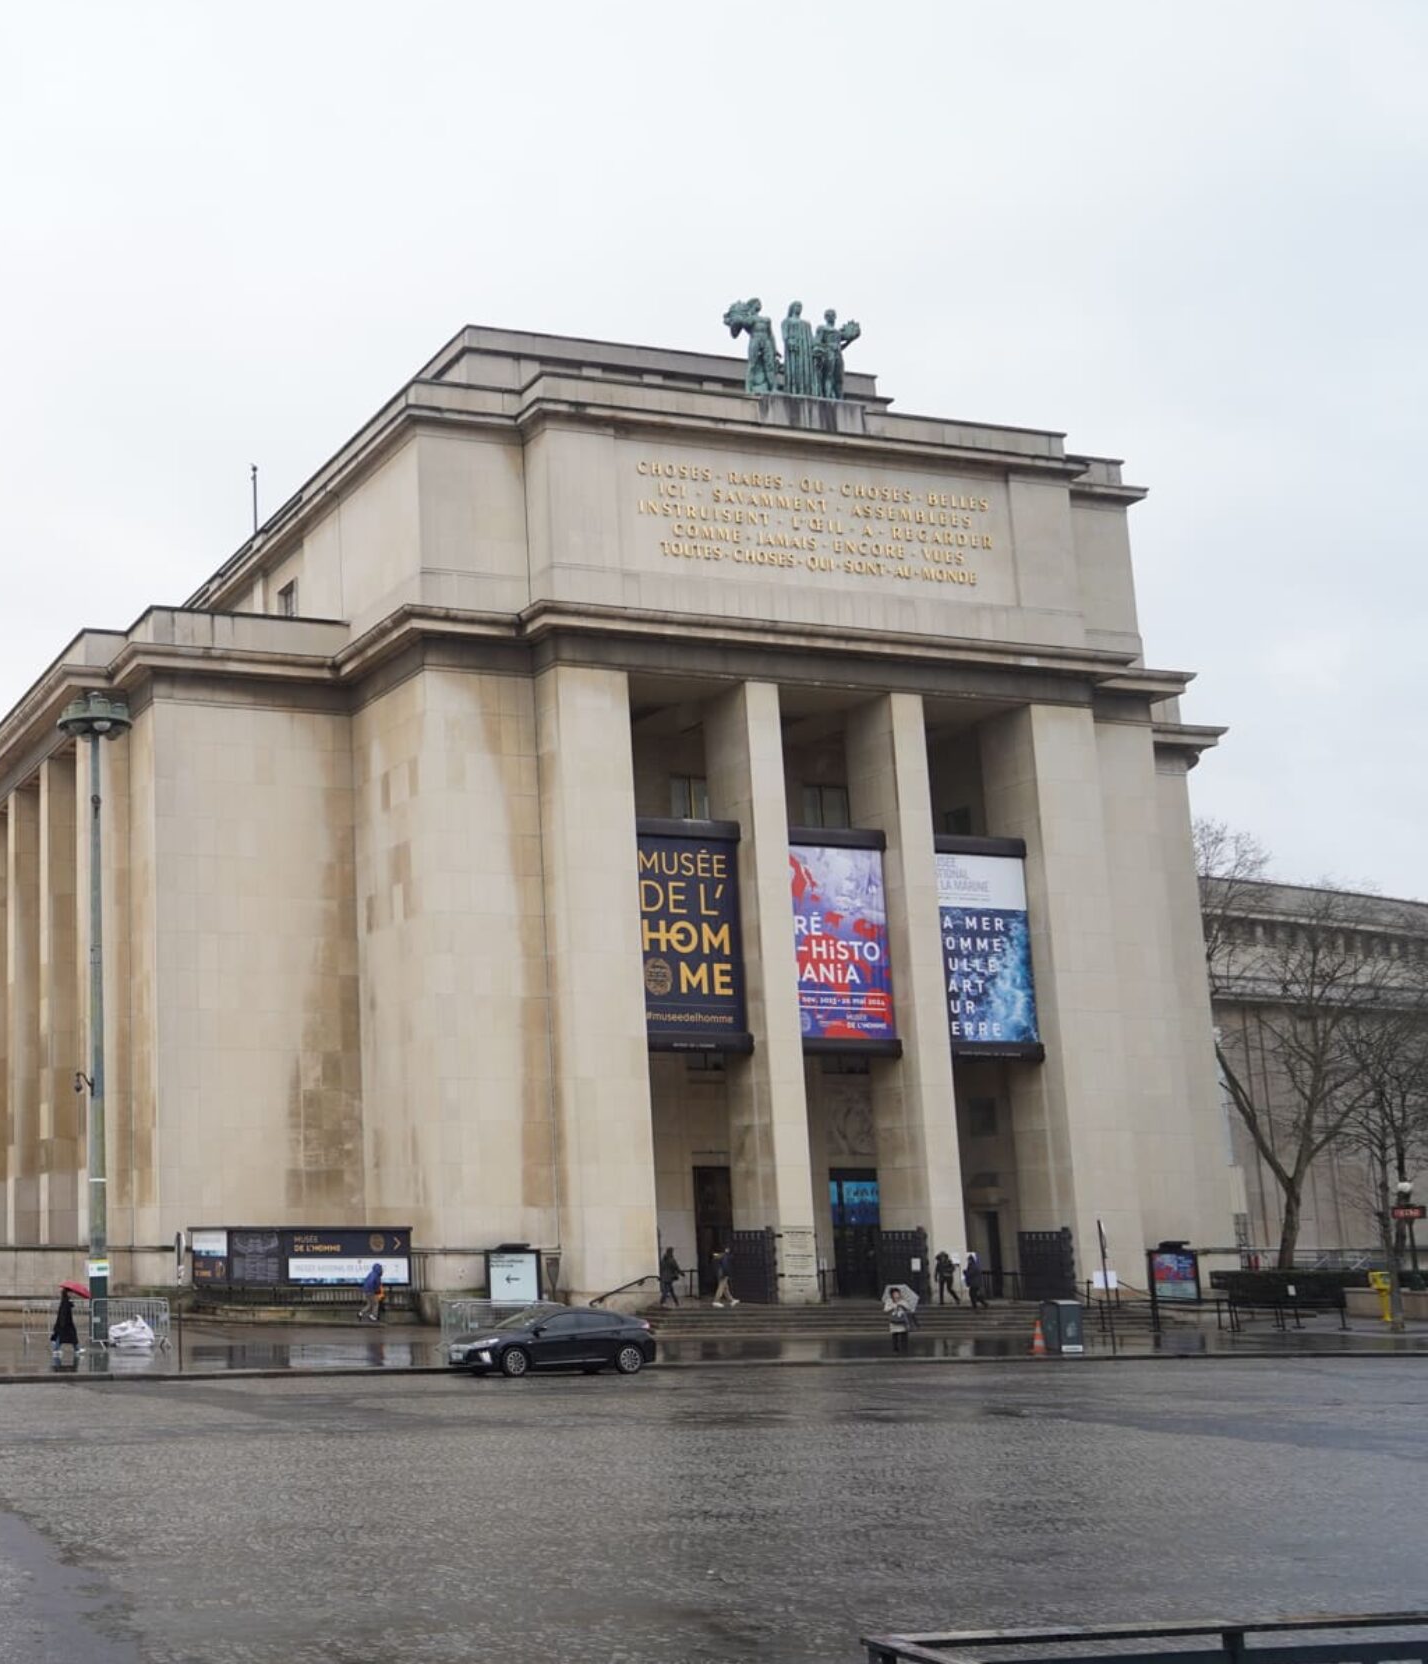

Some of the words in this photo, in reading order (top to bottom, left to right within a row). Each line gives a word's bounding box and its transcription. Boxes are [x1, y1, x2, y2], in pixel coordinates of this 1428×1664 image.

[637, 461, 712, 482] CHOSES
[728, 472, 784, 490] RARES
[800, 478, 824, 495] OU
[840, 483, 912, 503] CHOSES
[927, 493, 989, 512] BELLES
[658, 483, 687, 499] ICI
[712, 489, 827, 514] SAVAMMENT
[638, 500, 770, 527] INSTRUISENT
[862, 525, 873, 537] A
[892, 527, 993, 550] REGARDER
[673, 523, 741, 544] COMME
[756, 531, 818, 551] JAMAIS
[833, 540, 905, 560] ENCORE
[922, 547, 965, 566] VUES
[660, 540, 722, 561] TOUTES
[733, 549, 795, 568] CHOSES
[805, 556, 834, 572] QUI
[844, 560, 885, 577] SONT
[894, 566, 912, 580] AU
[922, 567, 978, 586] MONDE
[638, 849, 728, 878] MUSÉE
[640, 880, 688, 914] DE
[699, 883, 724, 915] L'
[794, 911, 822, 935] RÉ
[943, 915, 953, 930] A
[965, 916, 1005, 931] MER
[641, 919, 731, 955] HOM
[946, 936, 1002, 952] OMME
[798, 963, 861, 983] ANiA
[948, 957, 998, 973] ULLE
[679, 961, 734, 996] ME
[948, 979, 985, 993] ART
[950, 999, 976, 1015] UR
[951, 1020, 1002, 1037] ERRE
[294, 1244, 304, 1252] DE
